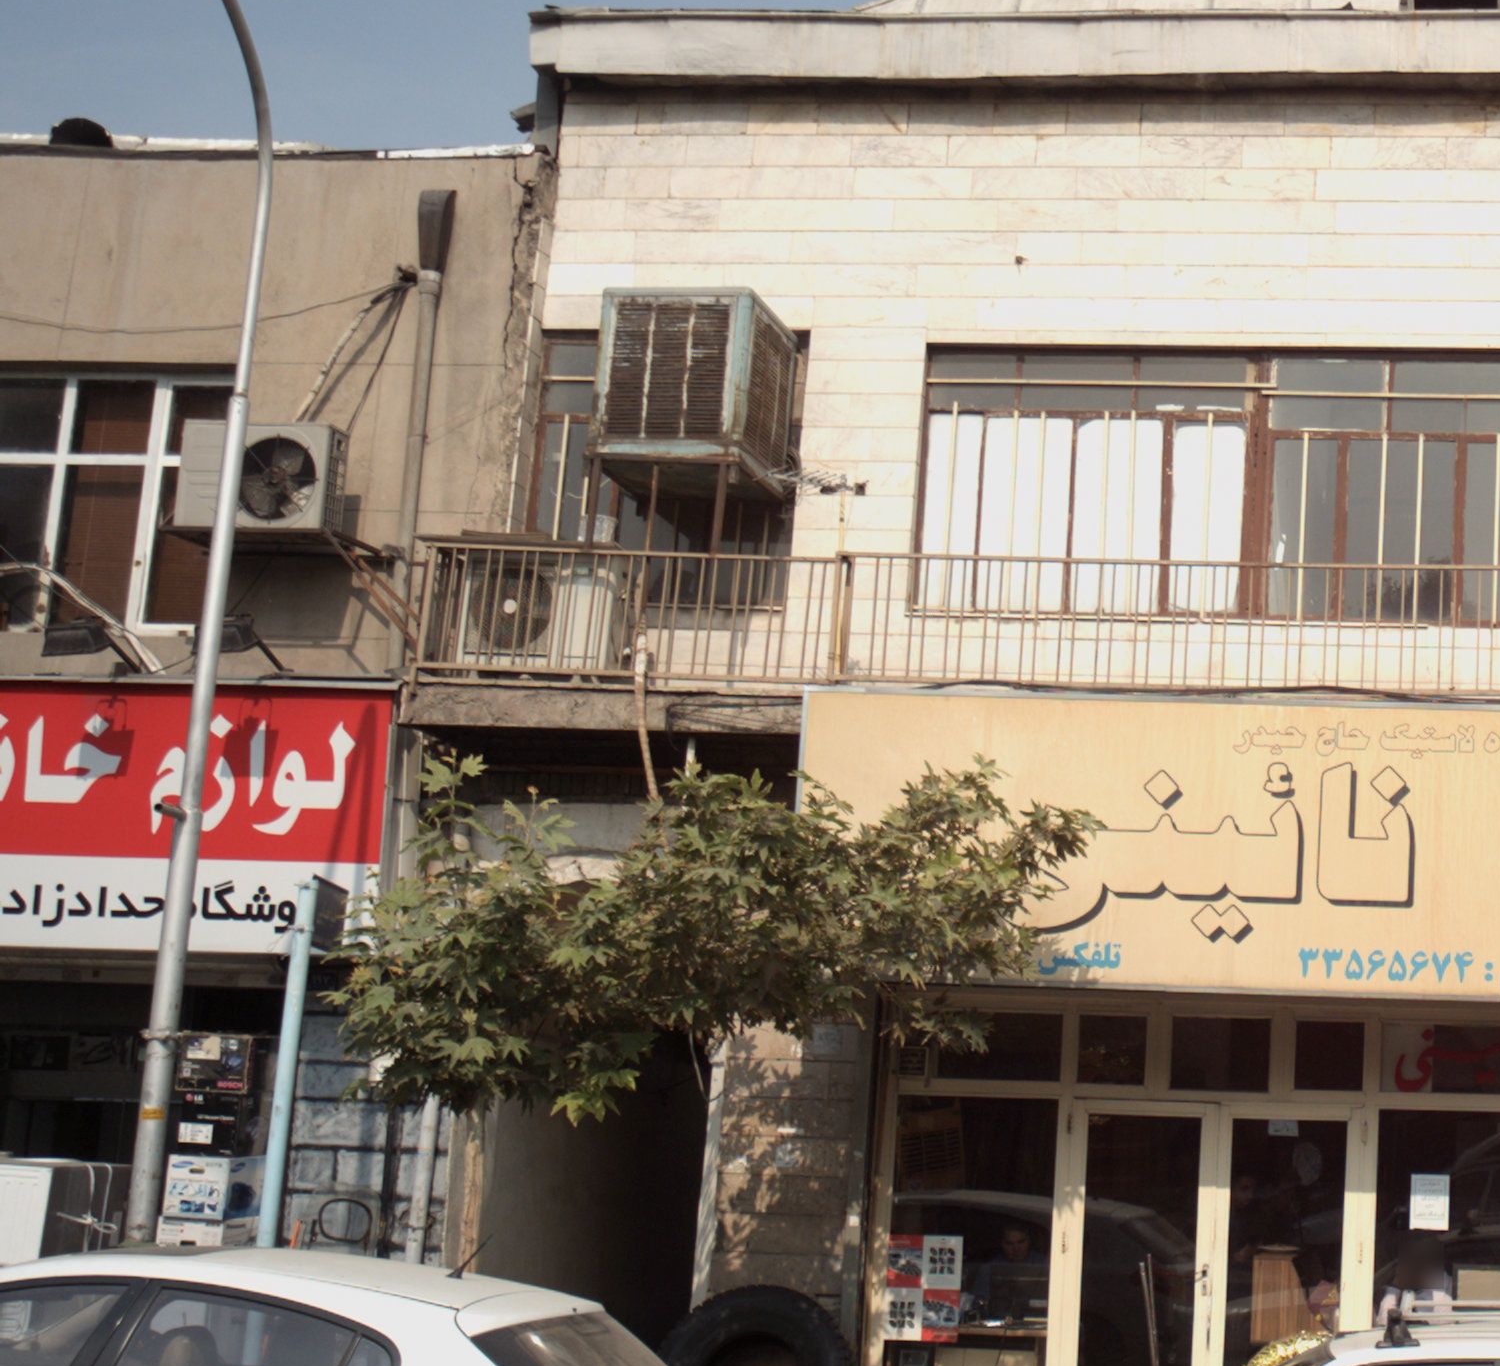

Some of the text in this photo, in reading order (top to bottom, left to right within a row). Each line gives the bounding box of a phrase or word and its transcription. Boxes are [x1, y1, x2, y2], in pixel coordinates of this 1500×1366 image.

[1232, 725, 1307, 756] حیدر
[1315, 721, 1371, 757] حاج
[1379, 723, 1476, 760] لاستیک
[149, 713, 356, 835] لوازم
[1037, 941, 1121, 976] تلفکس
[1298, 946, 1475, 984] ۳۳۵۶۵۶۷۴
